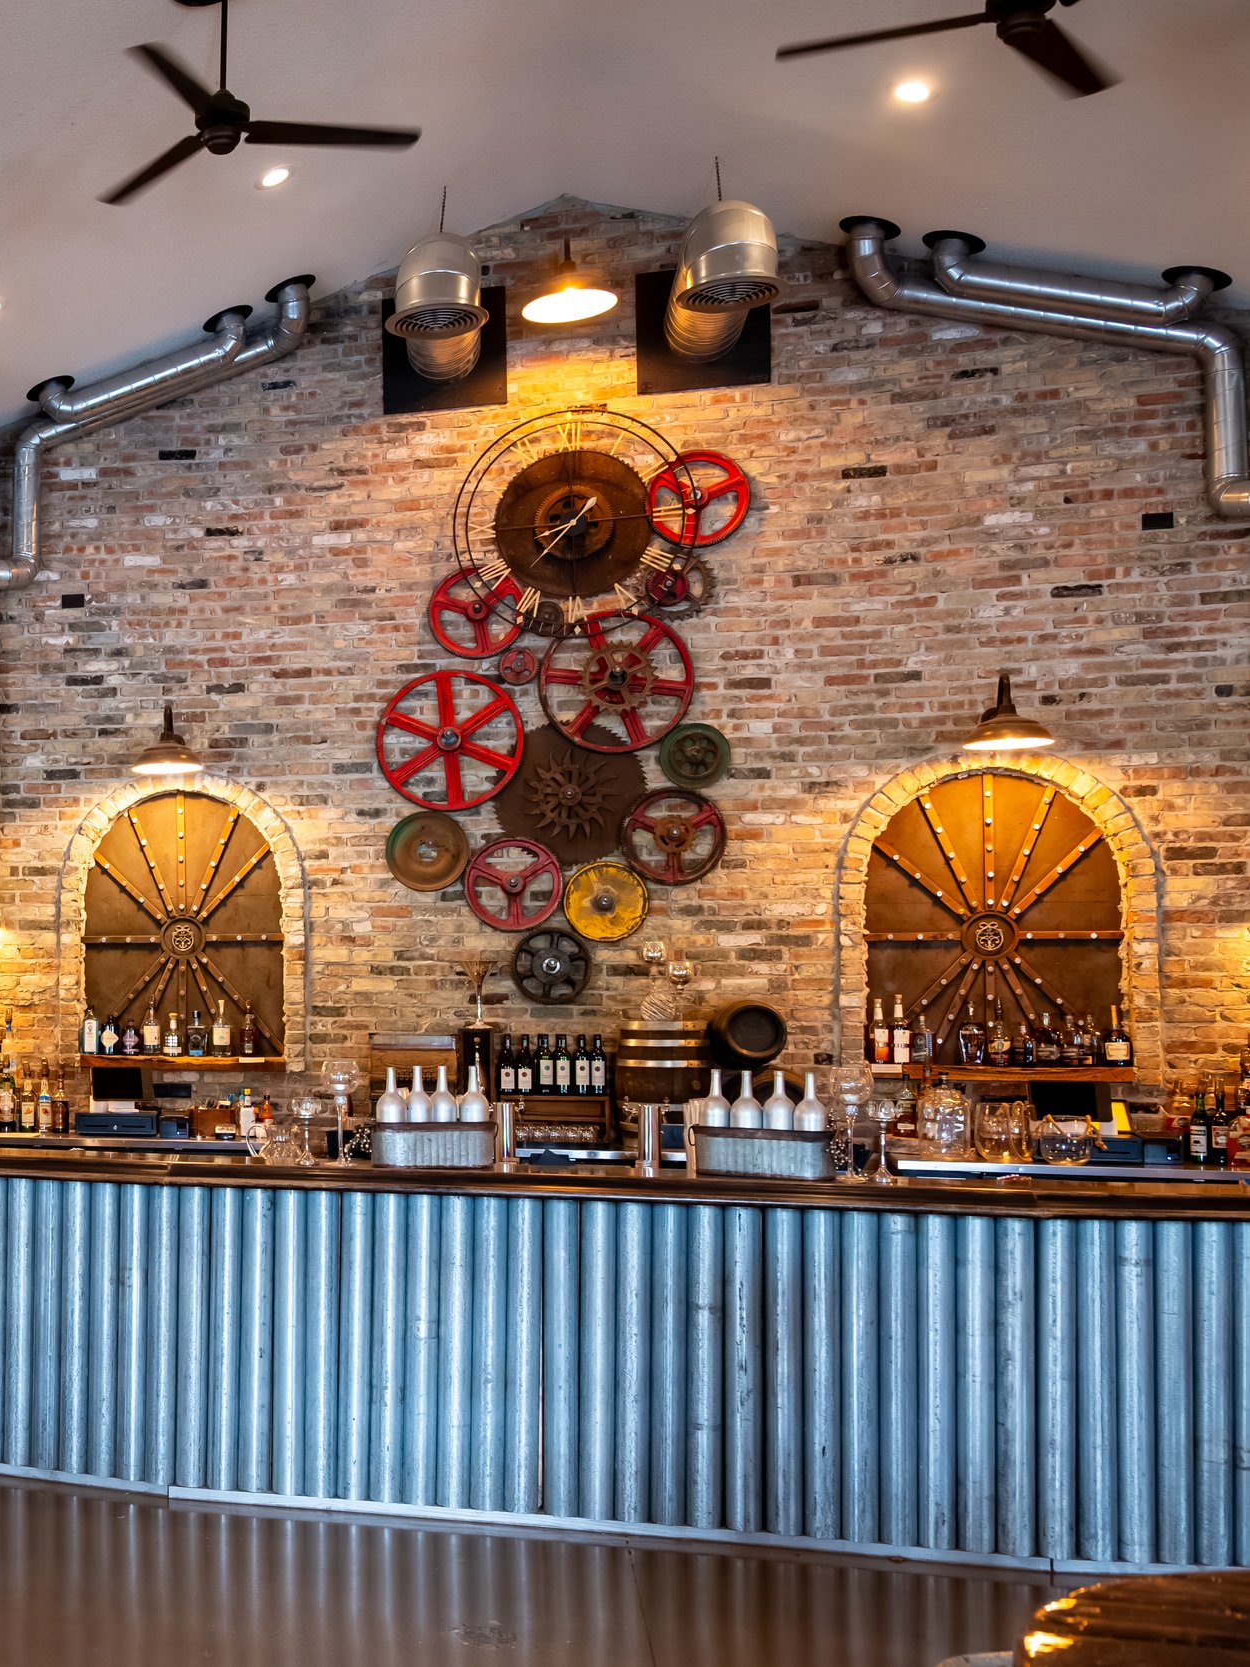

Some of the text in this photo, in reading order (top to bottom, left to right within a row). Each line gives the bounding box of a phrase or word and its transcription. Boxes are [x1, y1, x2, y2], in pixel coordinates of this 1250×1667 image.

[557, 421, 580, 452] XII
[652, 504, 683, 522] III
[468, 521, 497, 541] IX
[477, 558, 512, 591] VIII
[515, 586, 541, 618] VII
